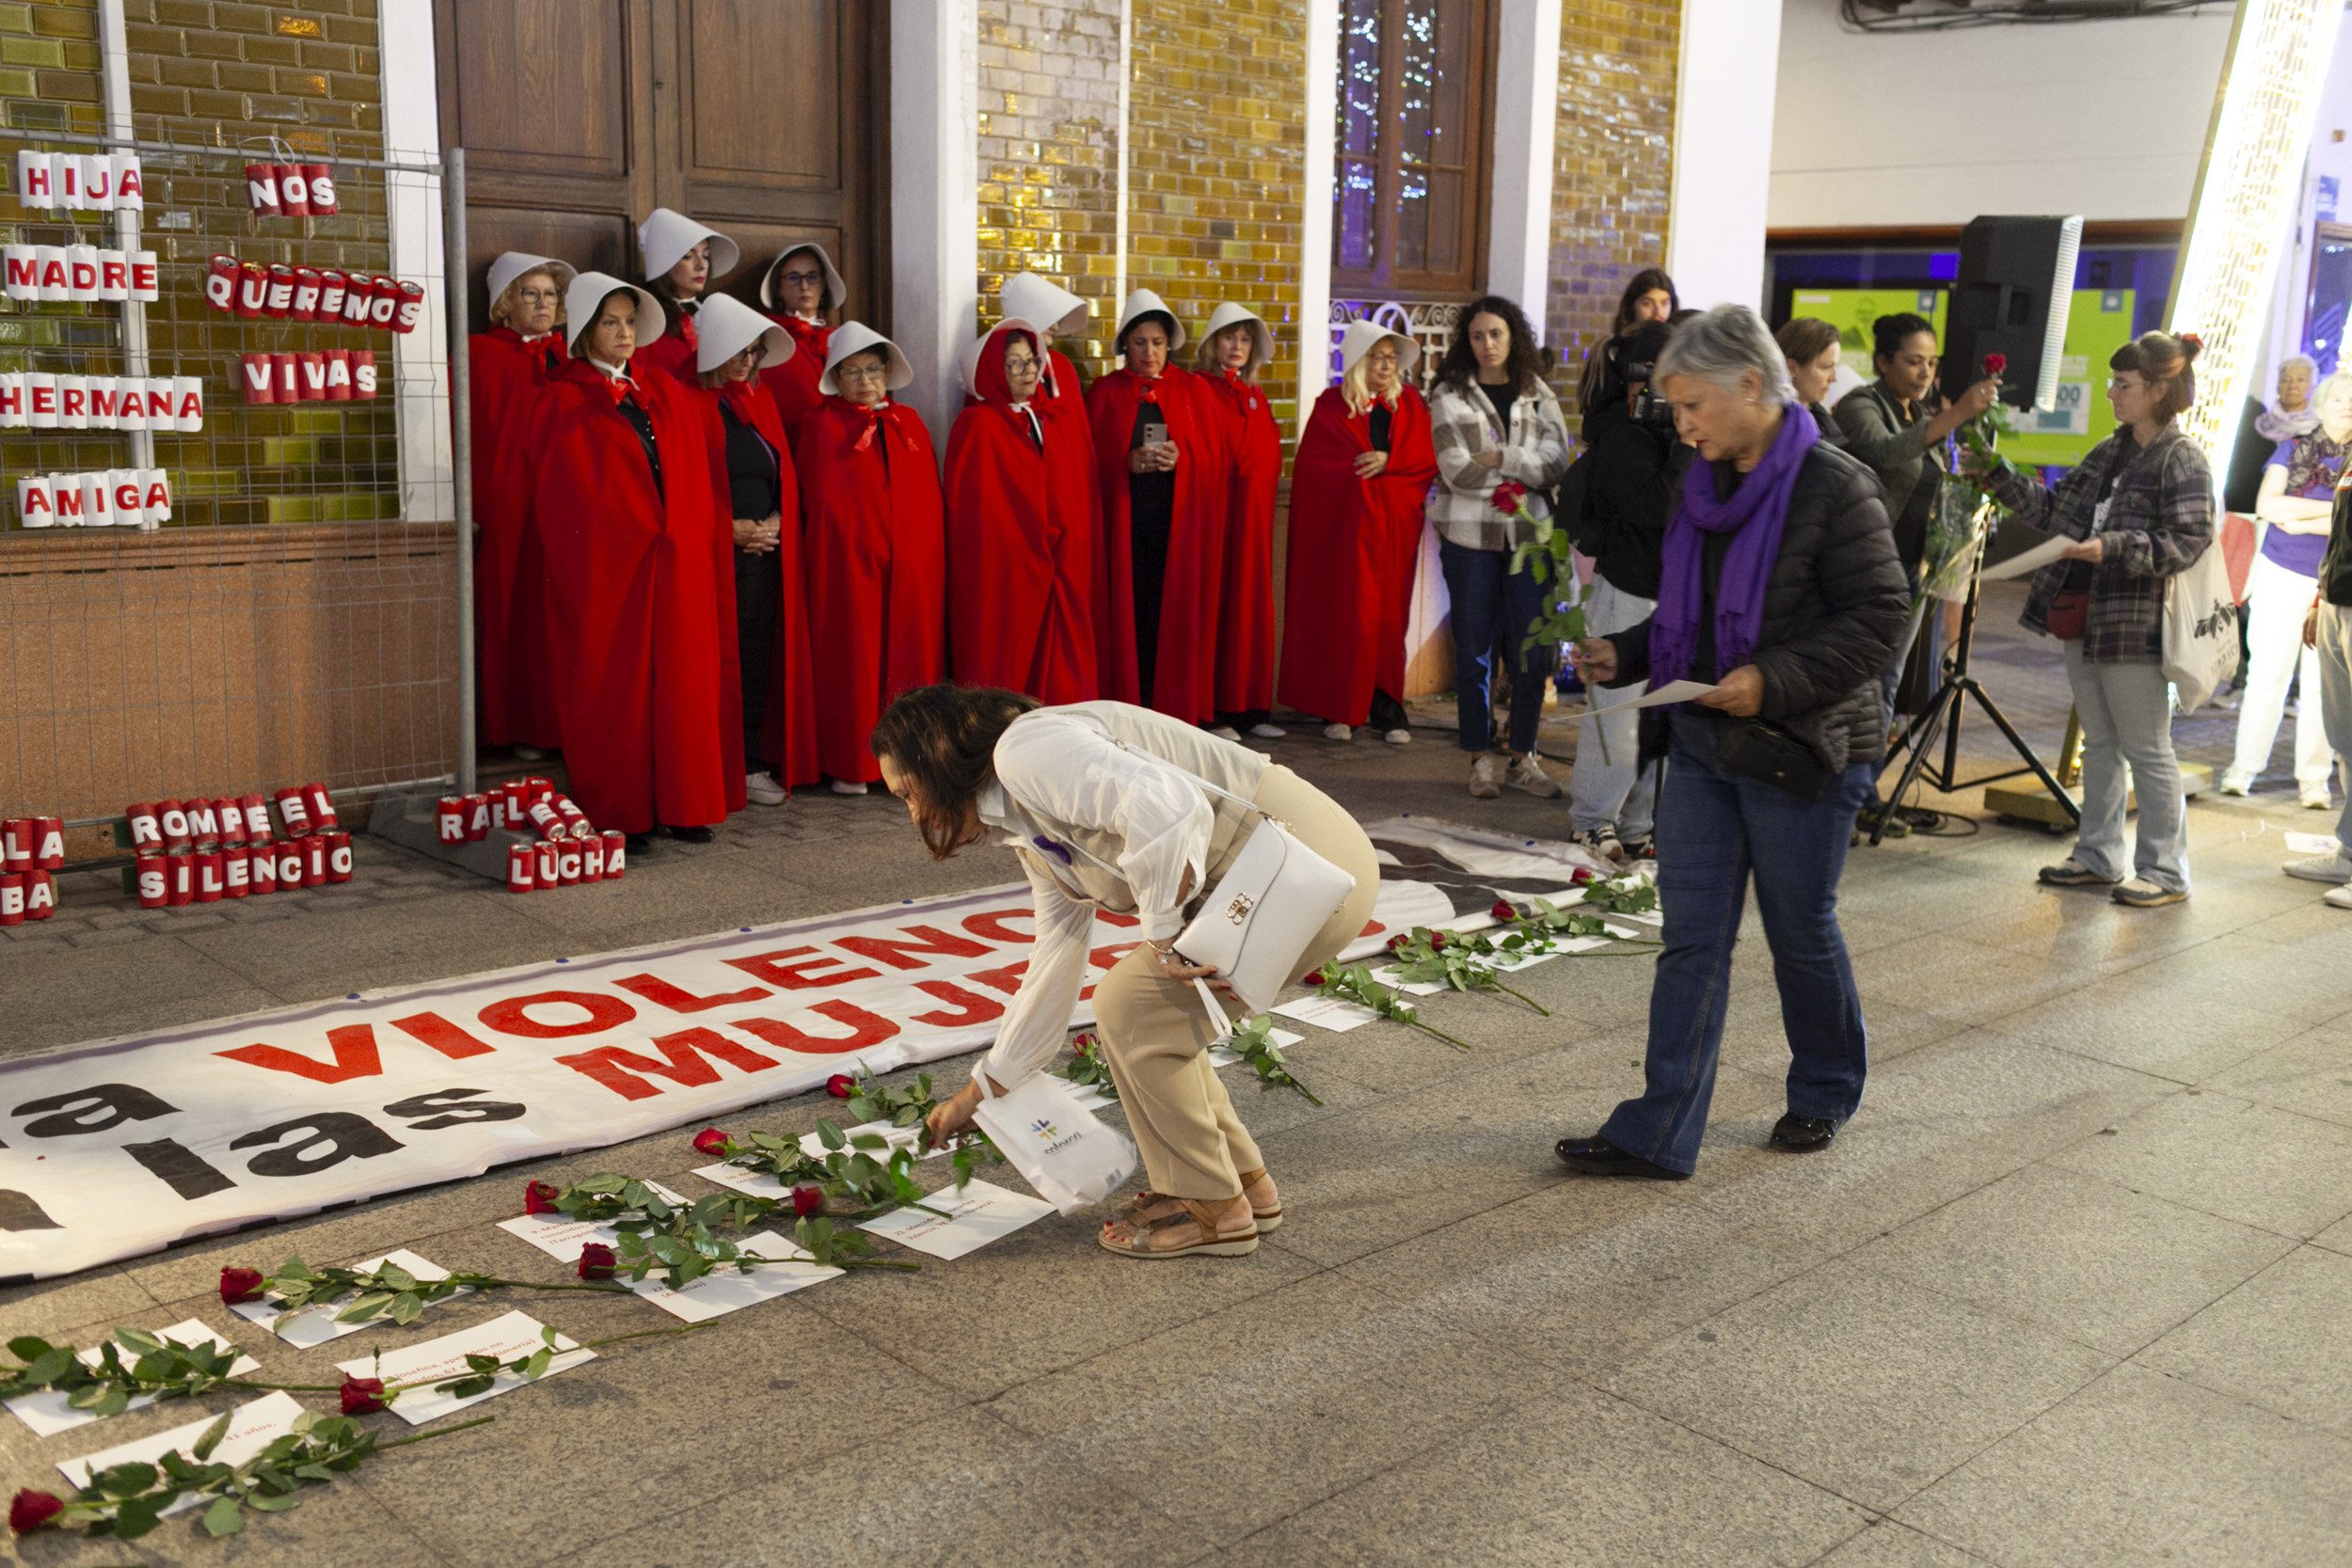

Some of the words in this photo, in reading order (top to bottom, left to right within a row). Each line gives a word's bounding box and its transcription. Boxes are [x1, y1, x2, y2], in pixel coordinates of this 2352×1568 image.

[27, 167, 143, 199] HIJA
[249, 177, 336, 208] NOS
[8, 258, 157, 291] MADRE
[207, 276, 422, 325] QUEREMOS
[246, 359, 376, 392] VIVAS
[0, 387, 203, 420] HERMANA
[24, 482, 169, 516] AMIGA
[132, 806, 271, 843] ROMPE
[279, 791, 336, 824] EL
[0, 832, 64, 860] LA
[141, 842, 352, 899] SILENCIO
[511, 848, 626, 884] LUCHA
[1, 882, 54, 915] BA
[0, 1083, 185, 1148] a
[212, 908, 1140, 1085] VIOLENC
[120, 1087, 527, 1201] las
